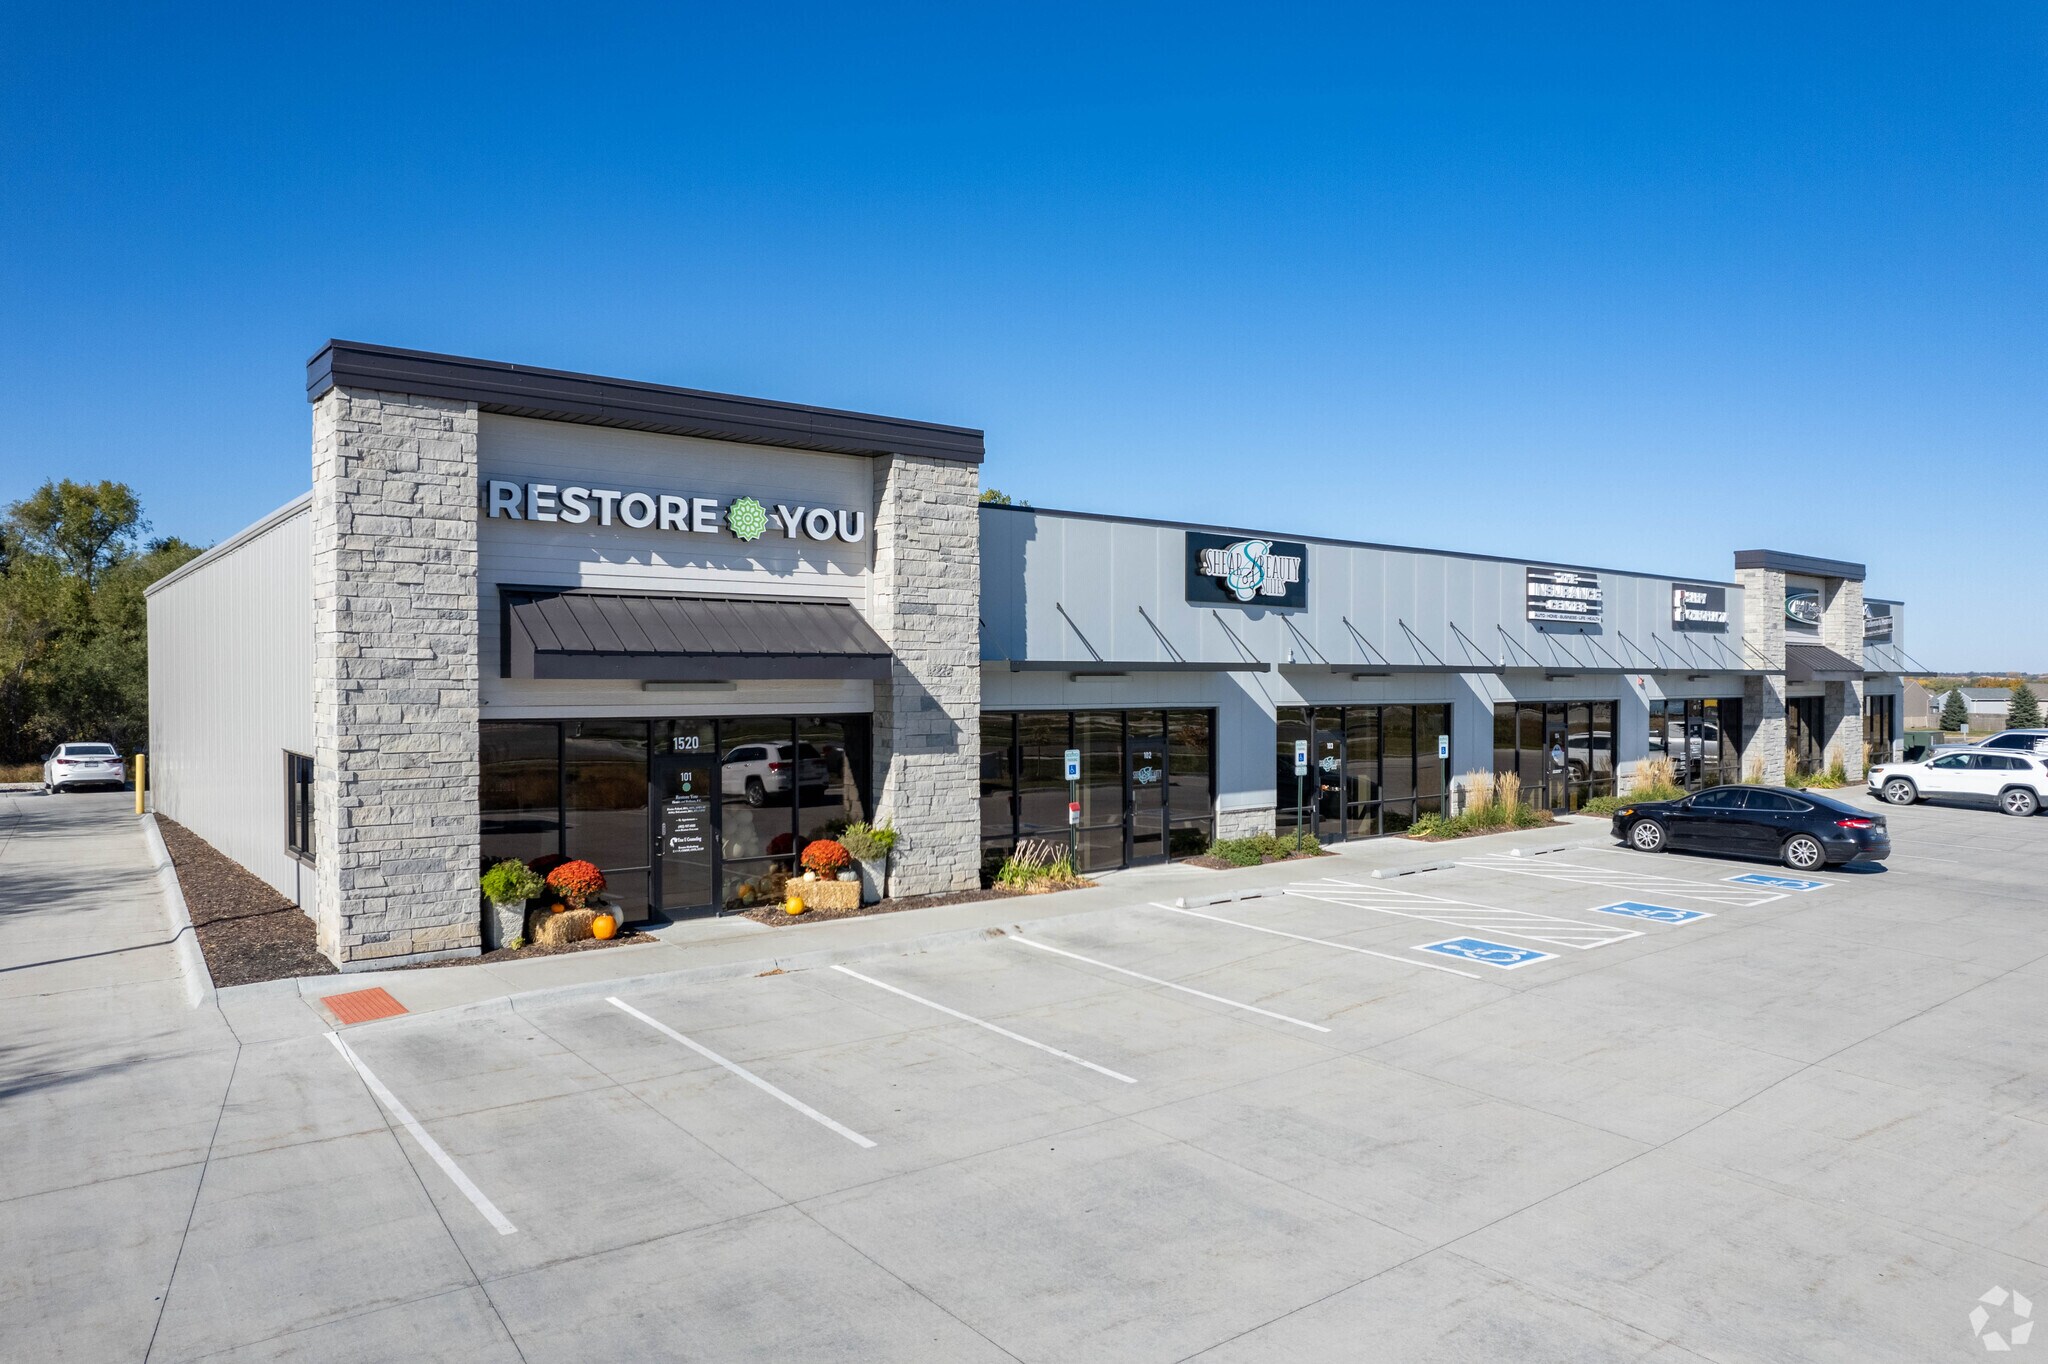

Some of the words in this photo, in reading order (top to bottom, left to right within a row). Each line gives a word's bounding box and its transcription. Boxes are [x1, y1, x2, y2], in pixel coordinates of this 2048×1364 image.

[487, 480, 718, 534] RESTORE
[774, 504, 865, 543] YOU
[1206, 550, 1242, 576] SHEAR
[1259, 555, 1301, 581] BEAUTY
[1261, 578, 1286, 595] SUITES
[1528, 583, 1602, 601] INSURANCE
[1545, 600, 1587, 613] CENTER
[673, 736, 700, 750] 1520
[1143, 751, 1152, 759] 102
[680, 772, 692, 782] 101
